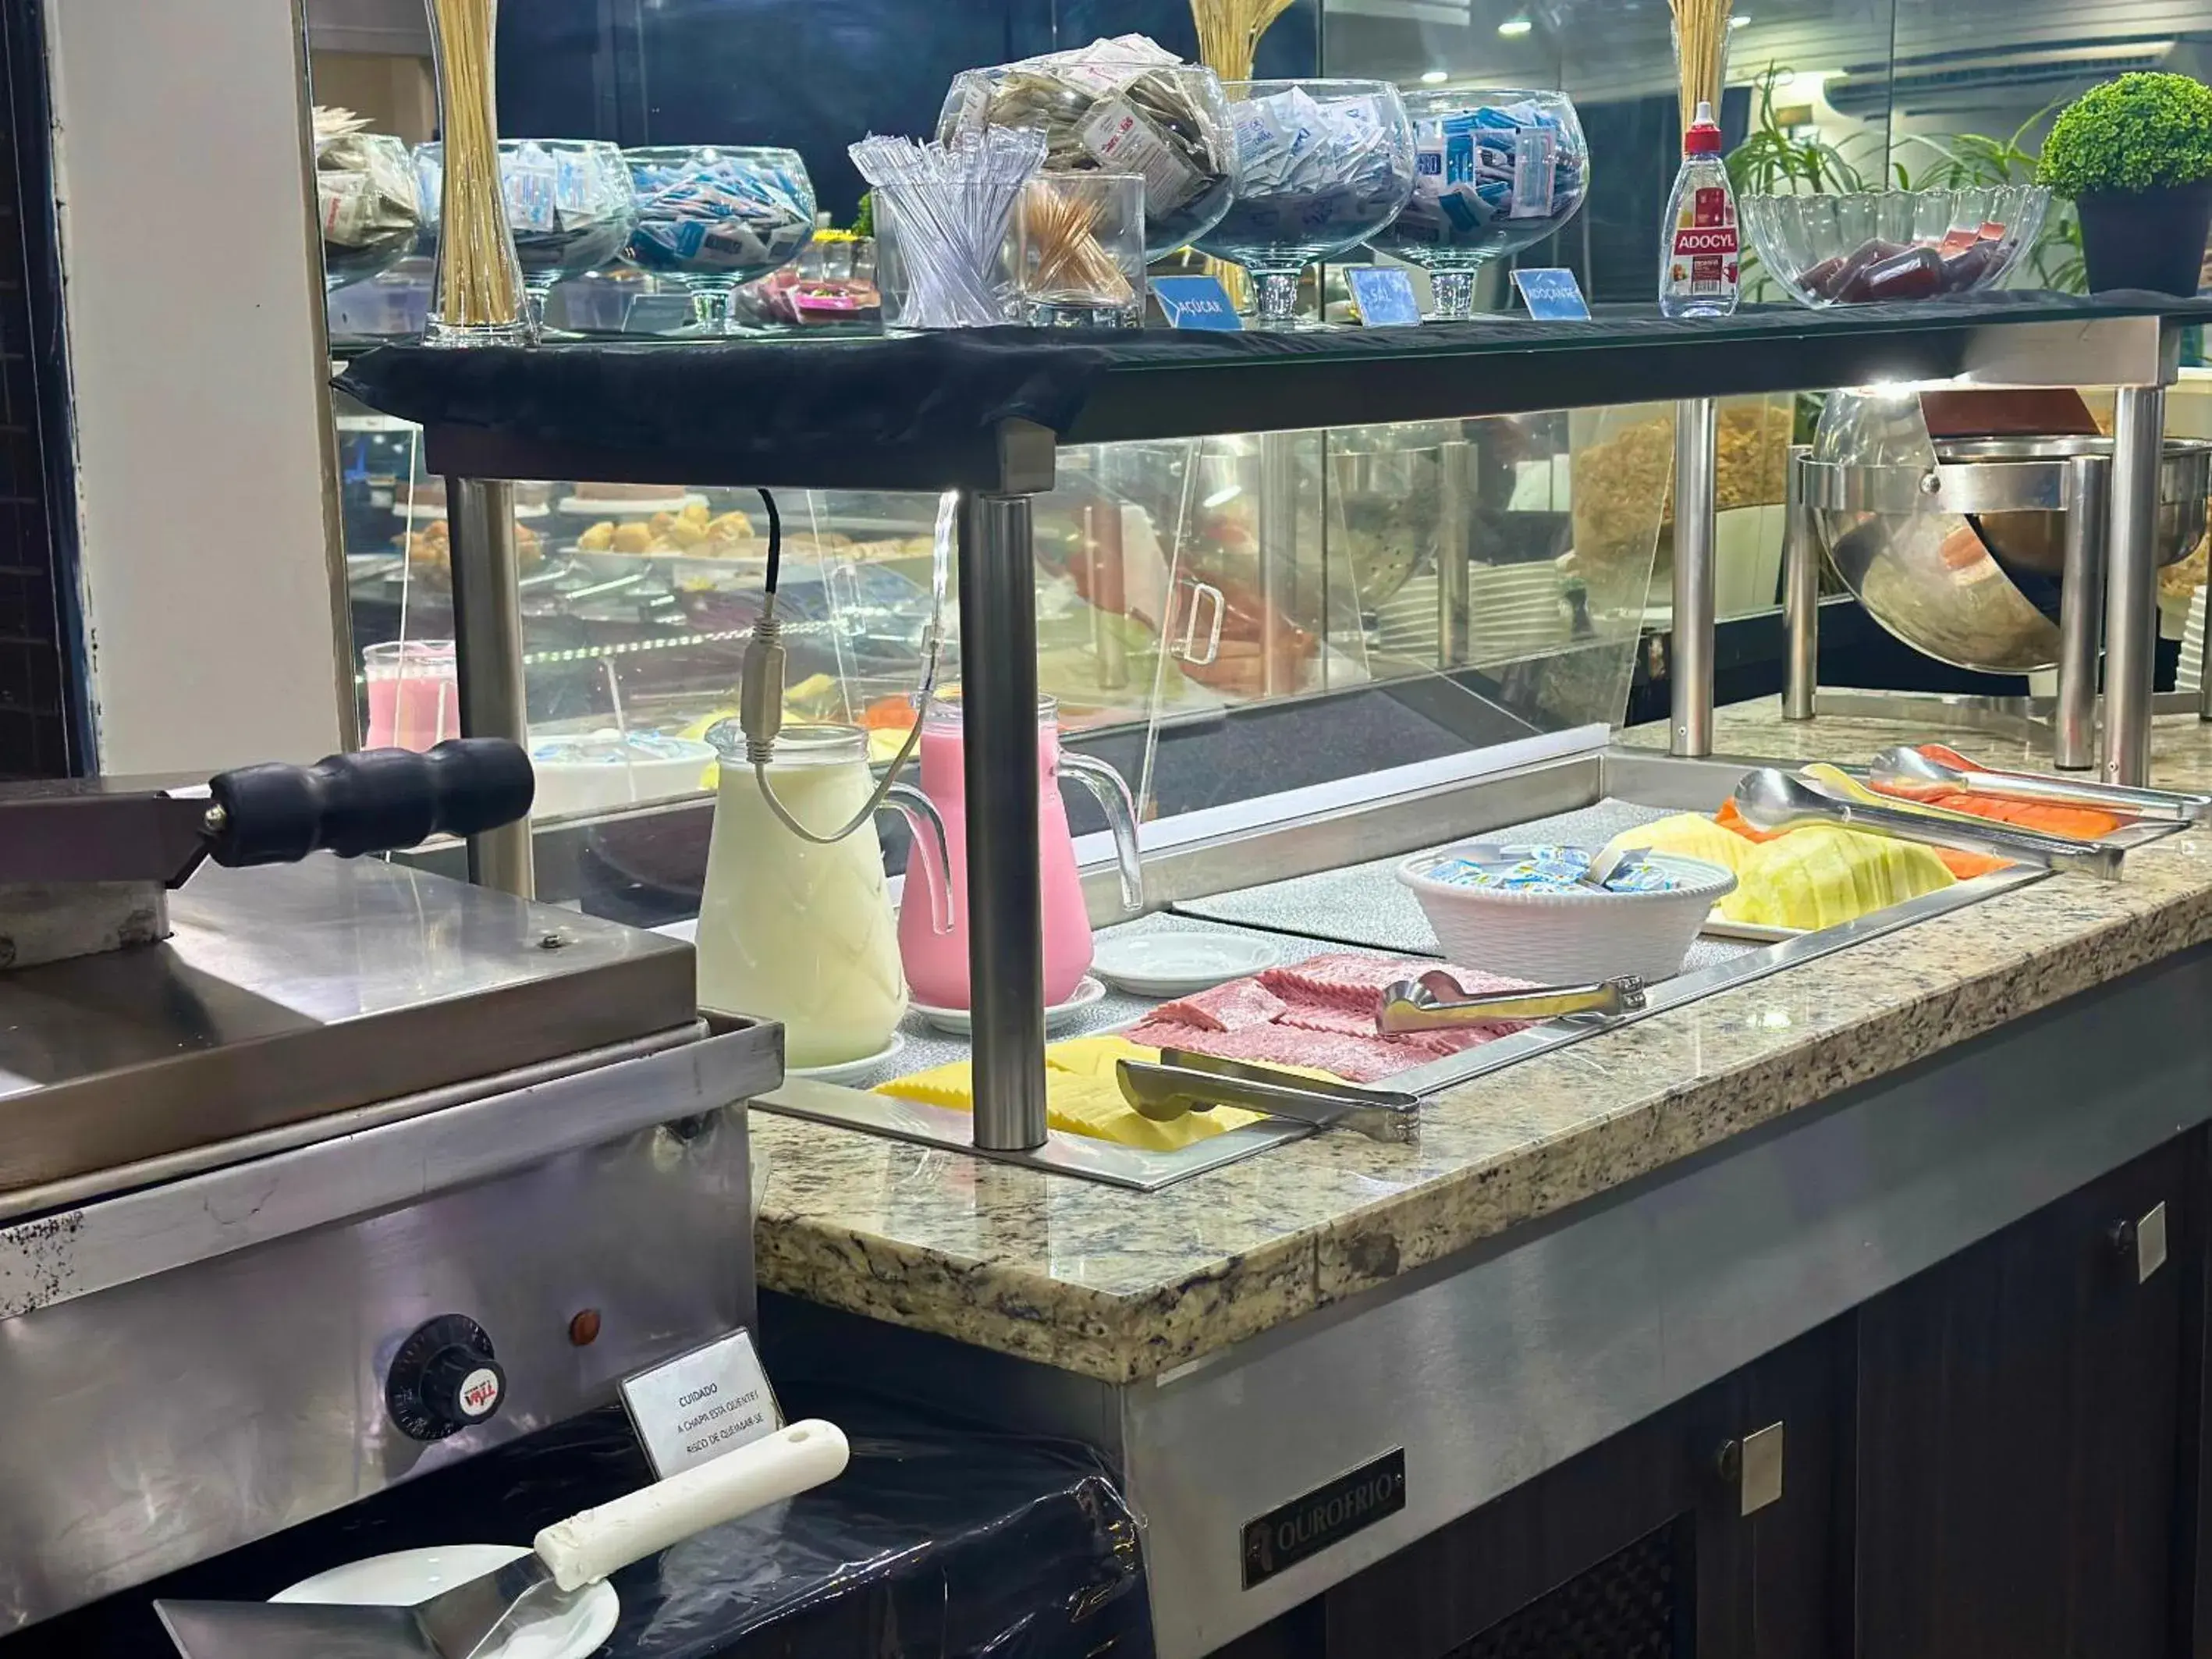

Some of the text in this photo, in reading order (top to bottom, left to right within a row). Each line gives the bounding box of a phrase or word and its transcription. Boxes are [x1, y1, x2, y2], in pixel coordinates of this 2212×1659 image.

[1679, 234, 1734, 249] ADOCYL
[1369, 286, 1393, 304] SAL
[1178, 298, 1223, 316] AÇÚCAR
[679, 1383, 717, 1407] CUIDADO
[677, 1425, 684, 1433] A
[683, 1413, 710, 1431] CHAPA
[708, 1433, 720, 1444] DE
[1277, 1473, 1393, 1551] OUROFRIO
